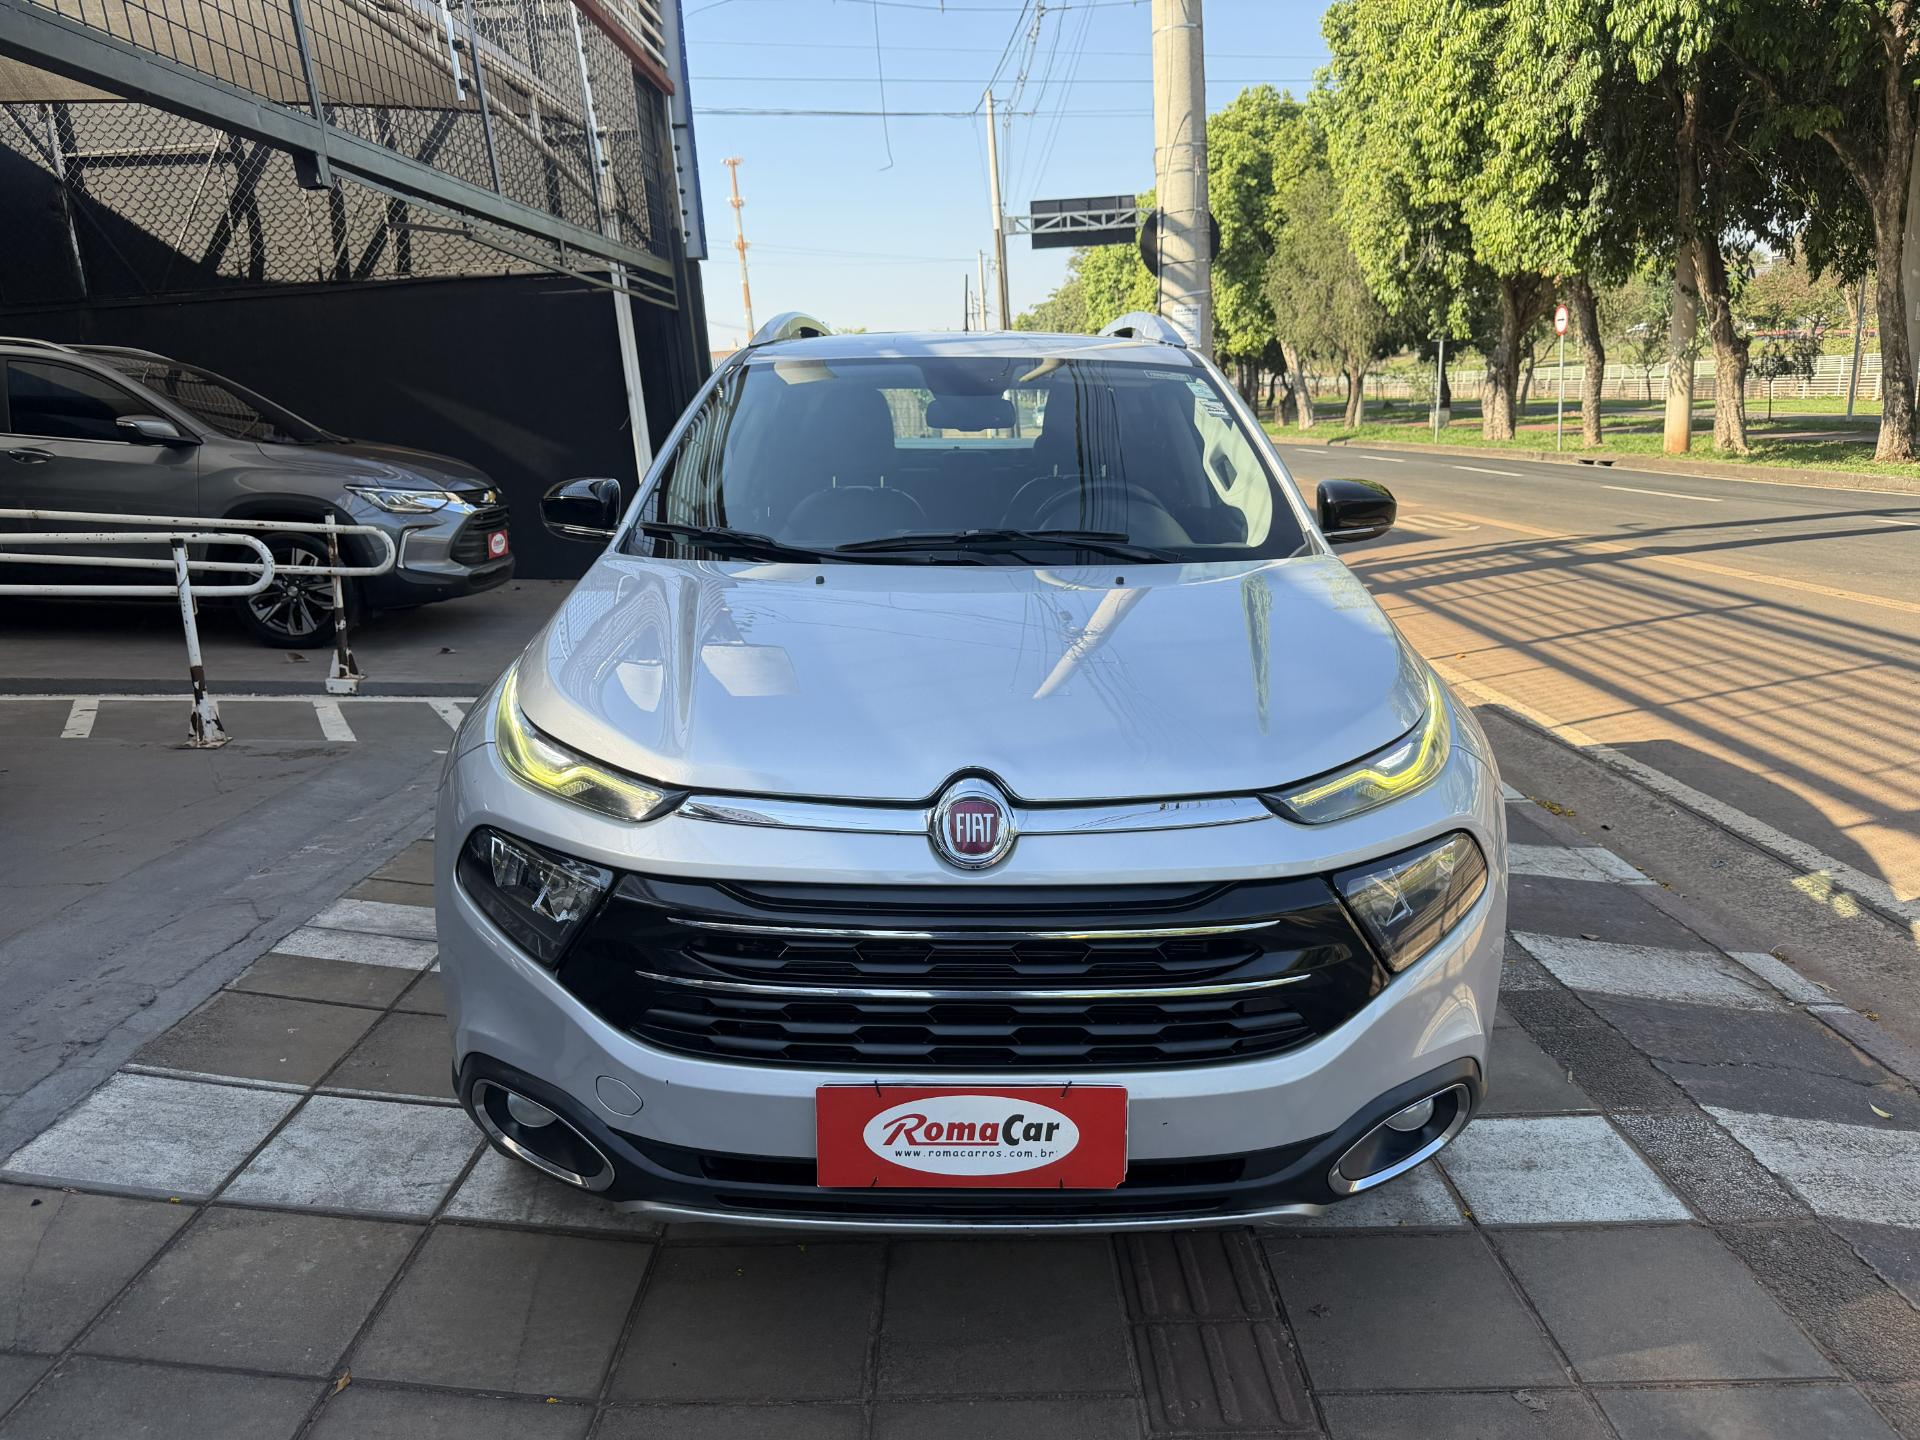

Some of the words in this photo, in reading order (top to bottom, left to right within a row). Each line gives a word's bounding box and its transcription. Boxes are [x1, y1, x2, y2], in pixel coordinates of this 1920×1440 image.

[955, 813, 995, 843] FIAT
[883, 1113, 1060, 1146] RomaCar
[894, 1148, 1055, 1159] www.romacarros.com.br
